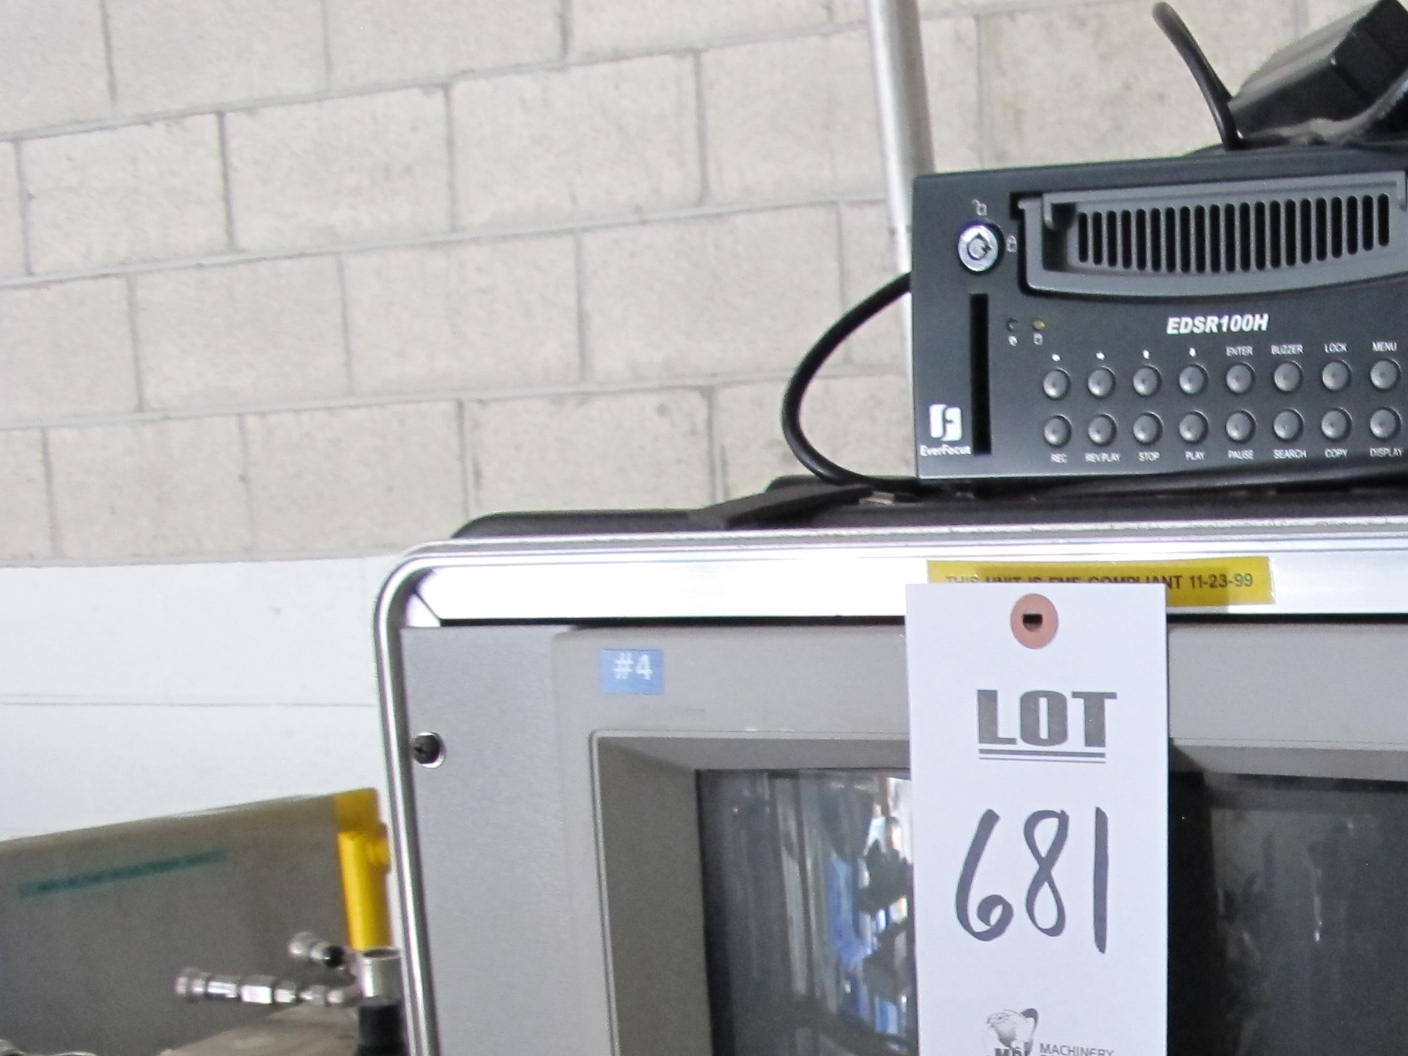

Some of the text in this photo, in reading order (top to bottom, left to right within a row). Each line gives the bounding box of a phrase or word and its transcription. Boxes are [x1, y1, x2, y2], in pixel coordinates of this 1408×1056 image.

[1166, 313, 1269, 334] EDSR100H
[1225, 345, 1254, 357] ENTER
[1324, 343, 1348, 353] LOCK
[1372, 341, 1397, 352] MENU
[919, 444, 972, 457] EverFocus
[1138, 451, 1160, 462] STOP
[1185, 450, 1205, 461] PLAY
[1227, 449, 1254, 460] PAUSE
[1272, 448, 1307, 459] SEARCH
[1324, 447, 1348, 459] COPY
[1369, 446, 1403, 458] DISPLAY
[1050, 453, 1068, 463] REC
[1189, 573, 1254, 589] 11-23-99
[613, 651, 653, 681] #4
[976, 688, 1118, 749] LOT
[955, 806, 1109, 955] 681
